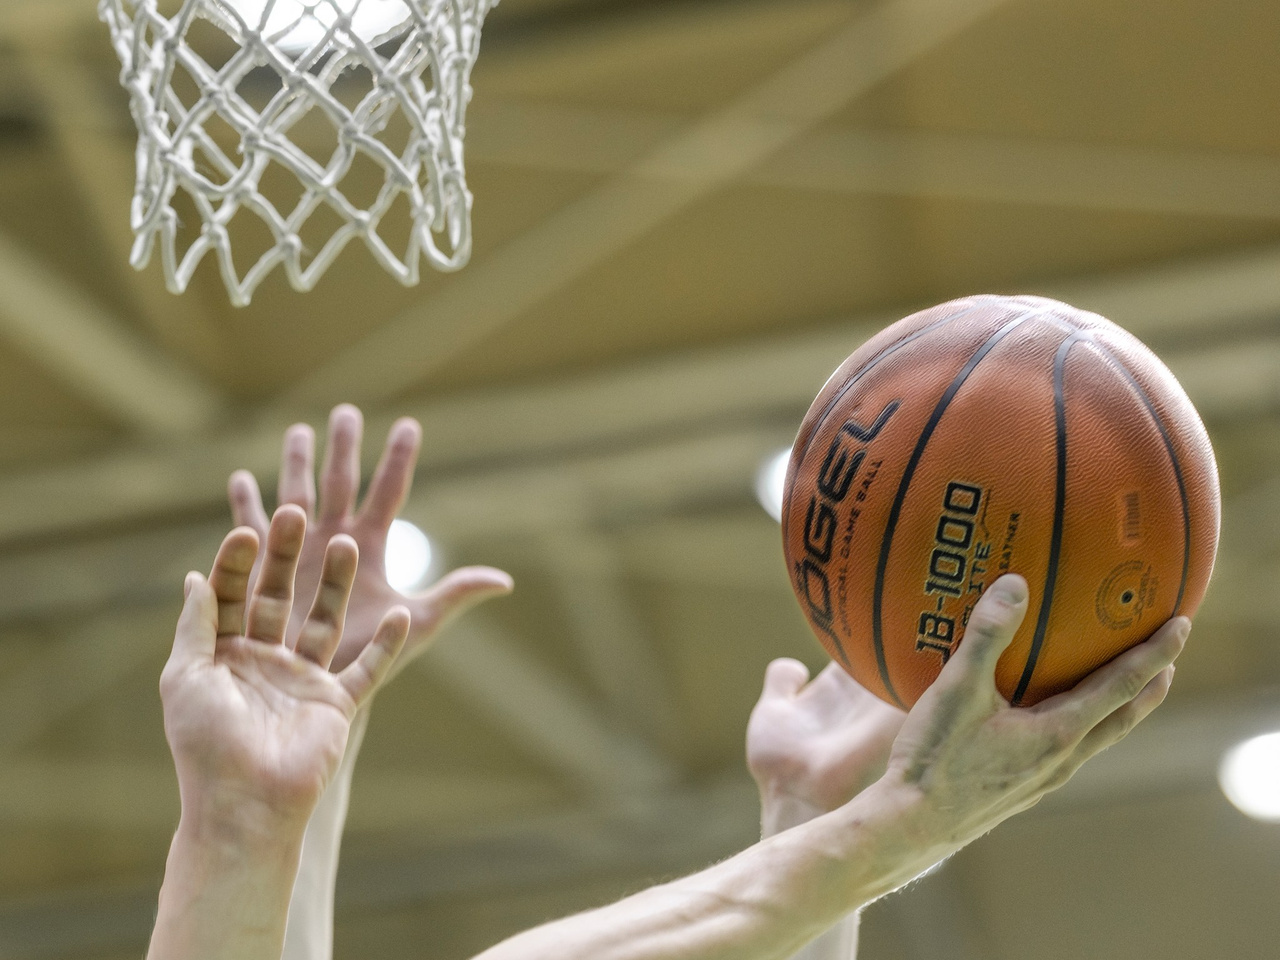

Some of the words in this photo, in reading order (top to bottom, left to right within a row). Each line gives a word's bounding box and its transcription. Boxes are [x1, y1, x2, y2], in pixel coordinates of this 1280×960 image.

[857, 459, 883, 503] BALL
[999, 512, 1021, 573] EATHER
[916, 481, 983, 666] JB-1000
